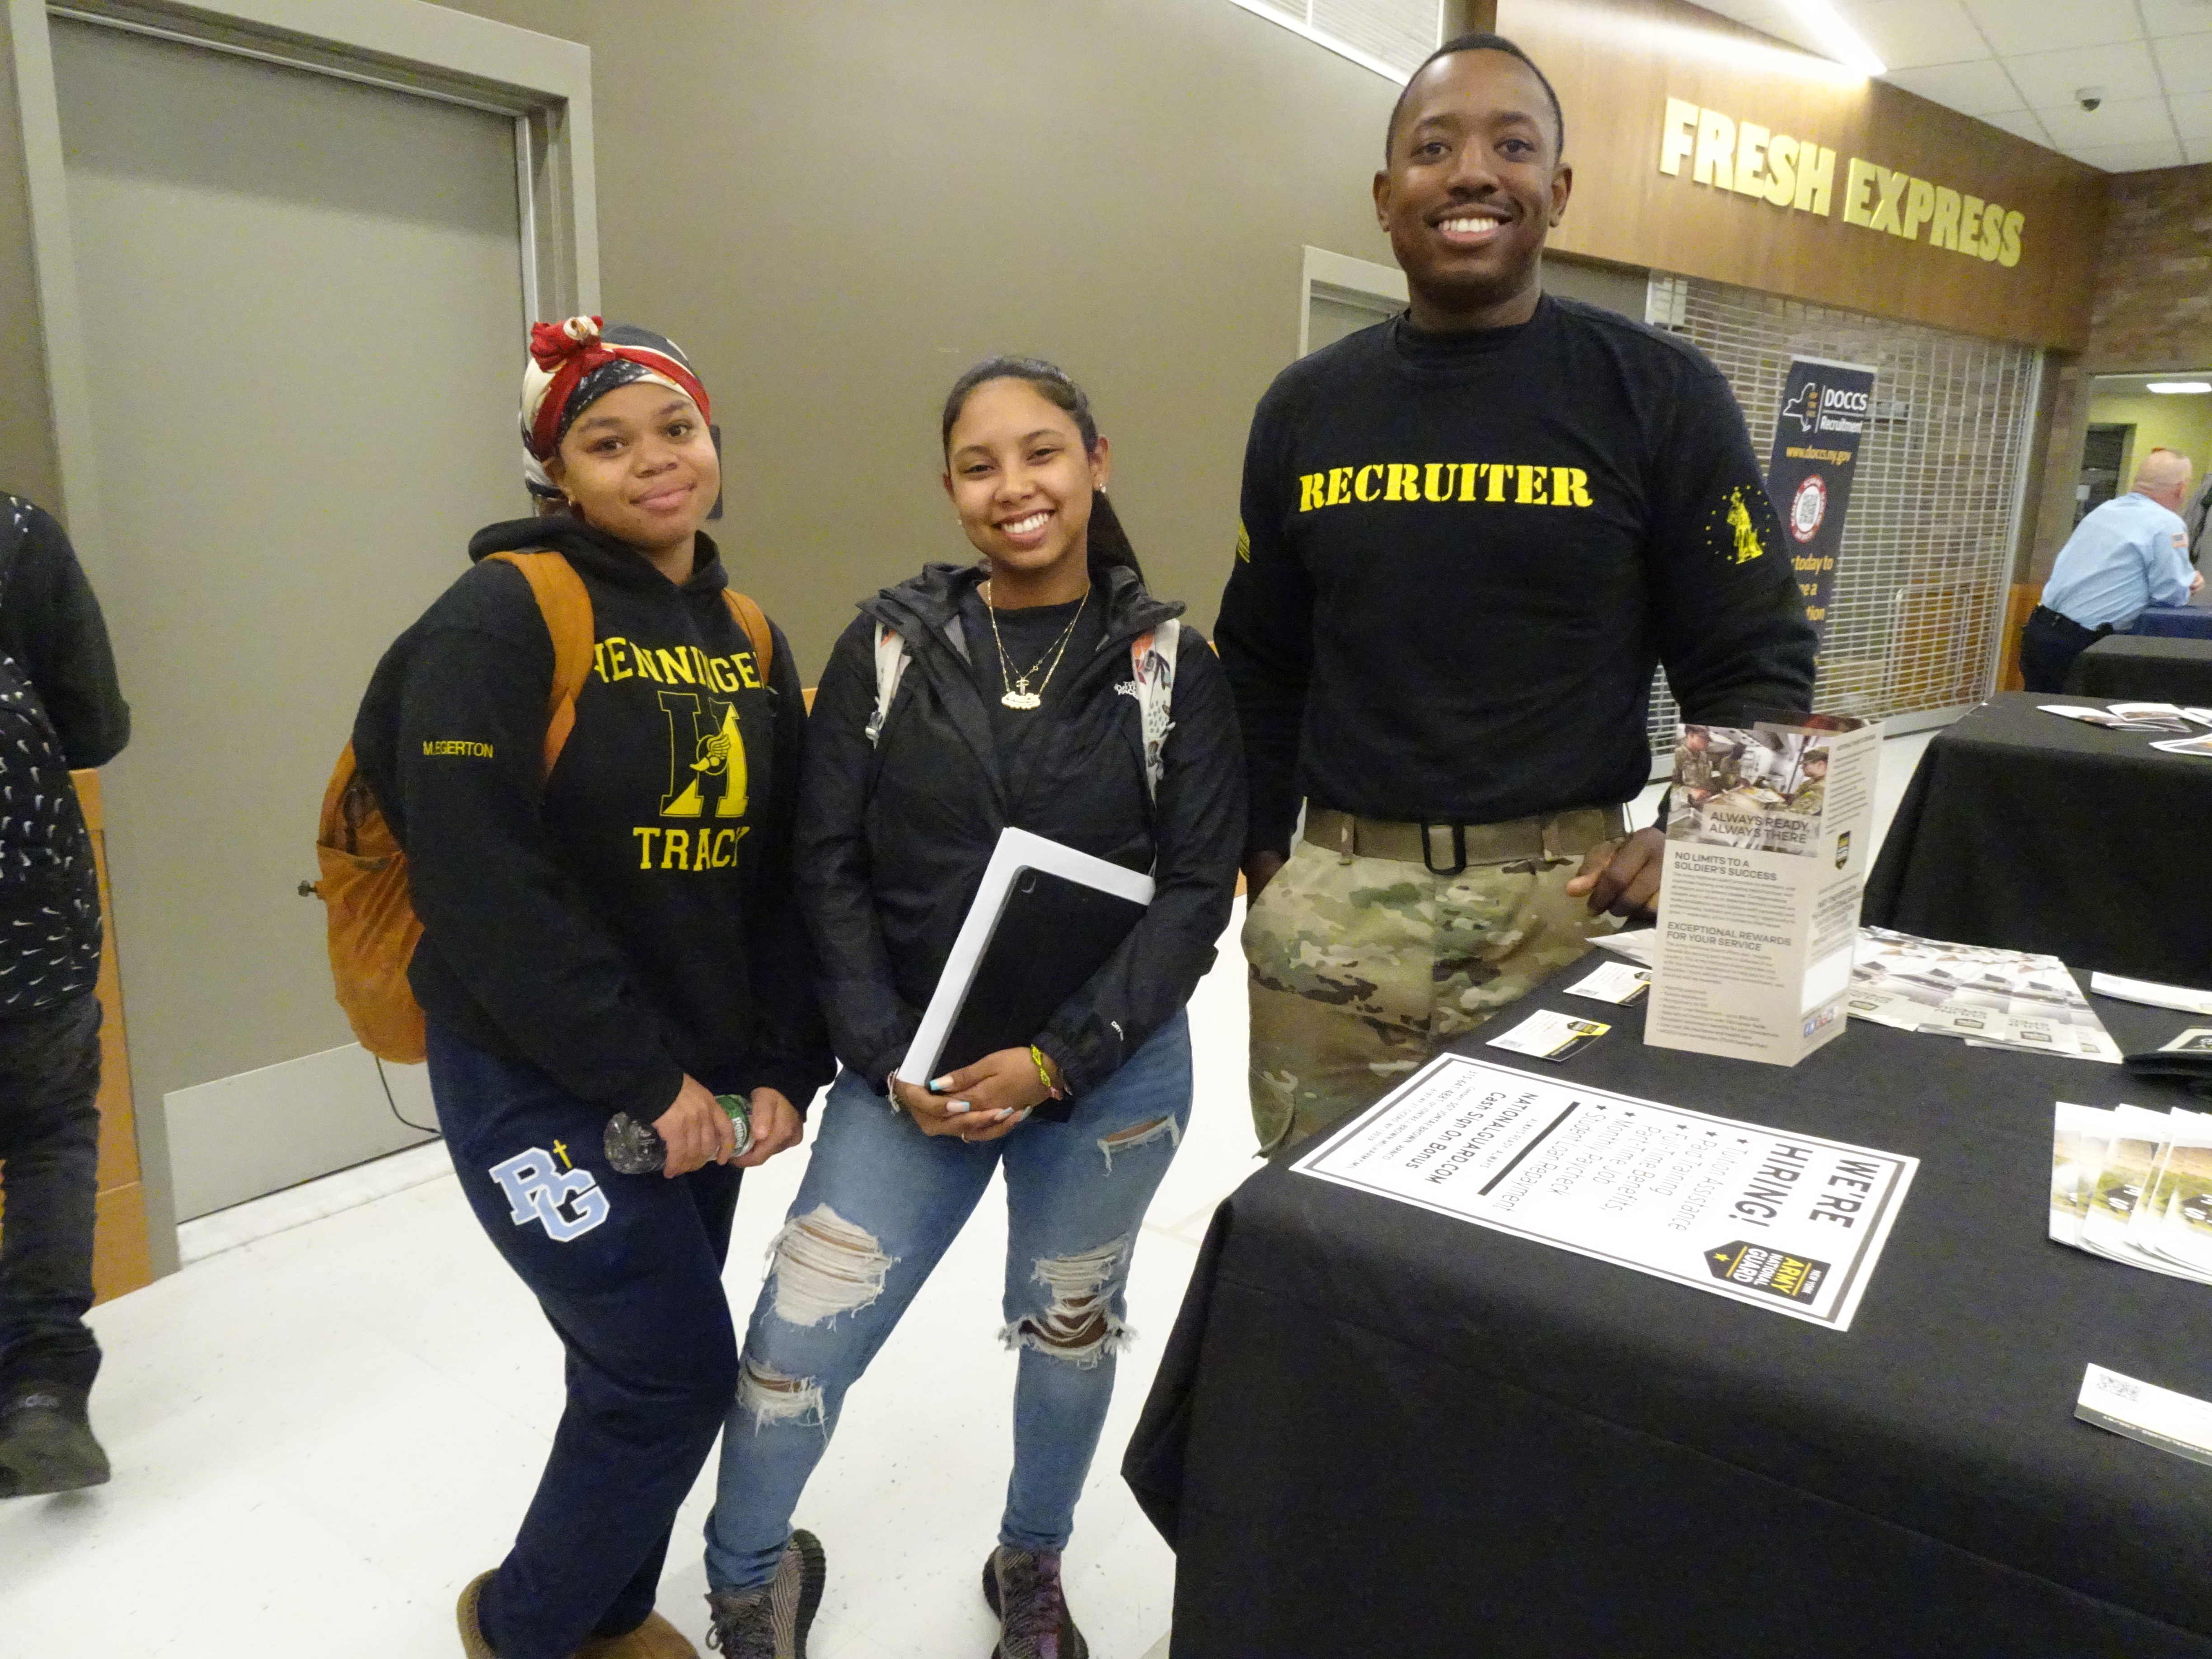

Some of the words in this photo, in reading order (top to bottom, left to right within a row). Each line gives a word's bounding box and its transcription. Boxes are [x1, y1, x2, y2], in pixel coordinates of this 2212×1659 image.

[1660, 97, 1836, 216] FRESH
[1844, 157, 2025, 267] EXPRESS
[1824, 389, 1868, 411] DOCCS
[1820, 415, 1863, 433] Recruitment
[1786, 445, 1852, 465] www.doccs.ny.gov
[1299, 463, 1593, 512] RECRUITER
[1795, 553, 1823, 576] today
[1823, 555, 1834, 571] to
[1805, 605, 1826, 621] tion
[1117, 689, 1139, 700] FACE
[1711, 811, 1762, 826] ALWAYS
[1765, 817, 1810, 832] READY,
[1709, 823, 1762, 838] ALWAYS
[1764, 829, 1807, 844] THERE
[1674, 861, 1727, 875] SOLDIER'S
[1728, 868, 1777, 881] SUCCESS
[1675, 852, 1691, 861] NO
[1692, 853, 1726, 865] LIMITS
[1728, 857, 1741, 867] TO
[1743, 859, 1750, 867] A
[1666, 931, 1687, 941] FOR
[1689, 933, 1716, 945] YOUR
[1718, 938, 1763, 951] SERVICE
[1667, 922, 1738, 938] EXCEPTIONAL
[1739, 931, 1792, 946] REWARDS
[1436, 1070, 1478, 1102] 315-641-4881
[1445, 1101, 1459, 1111] SGT
[1475, 1092, 1507, 1110] Cash
[1453, 1111, 1484, 1128] Sign
[1515, 1118, 1538, 1134] ALWAYS
[1561, 1111, 1607, 1142] Student
[1425, 1092, 1539, 1184] NATIONALGUARD.COM
[1438, 1129, 1462, 1141] On
[1585, 1118, 1634, 1151] Monthly
[1609, 1125, 1662, 1165] Part-Time
[1405, 1142, 1448, 1169] Bonus
[1479, 1149, 1504, 1168] ALWAYS
[1542, 1140, 1577, 1161] Loan
[1638, 1131, 1688, 1168] Full-Time
[1684, 1138, 1718, 1159] Paid
[1707, 1147, 1749, 1176] Tuition
[1548, 1152, 1603, 1195] Paycheck
[1592, 1165, 1622, 1184] Job
[1649, 1159, 1703, 1196] Training
[1728, 1143, 1814, 1227] HIRING!
[1492, 1161, 1558, 1212] Repayment
[1600, 1168, 1656, 1211] Benefits,
[1808, 1159, 1880, 1228] WE'RE
[1667, 1176, 1724, 1231] Assistance
[1732, 1247, 1769, 1283] GUARD
[1753, 1252, 1784, 1285] NATIONAL
[1770, 1256, 1804, 1294] ARMY
[1808, 1269, 1822, 1282] NEW
[1801, 1280, 1816, 1294] YORK
